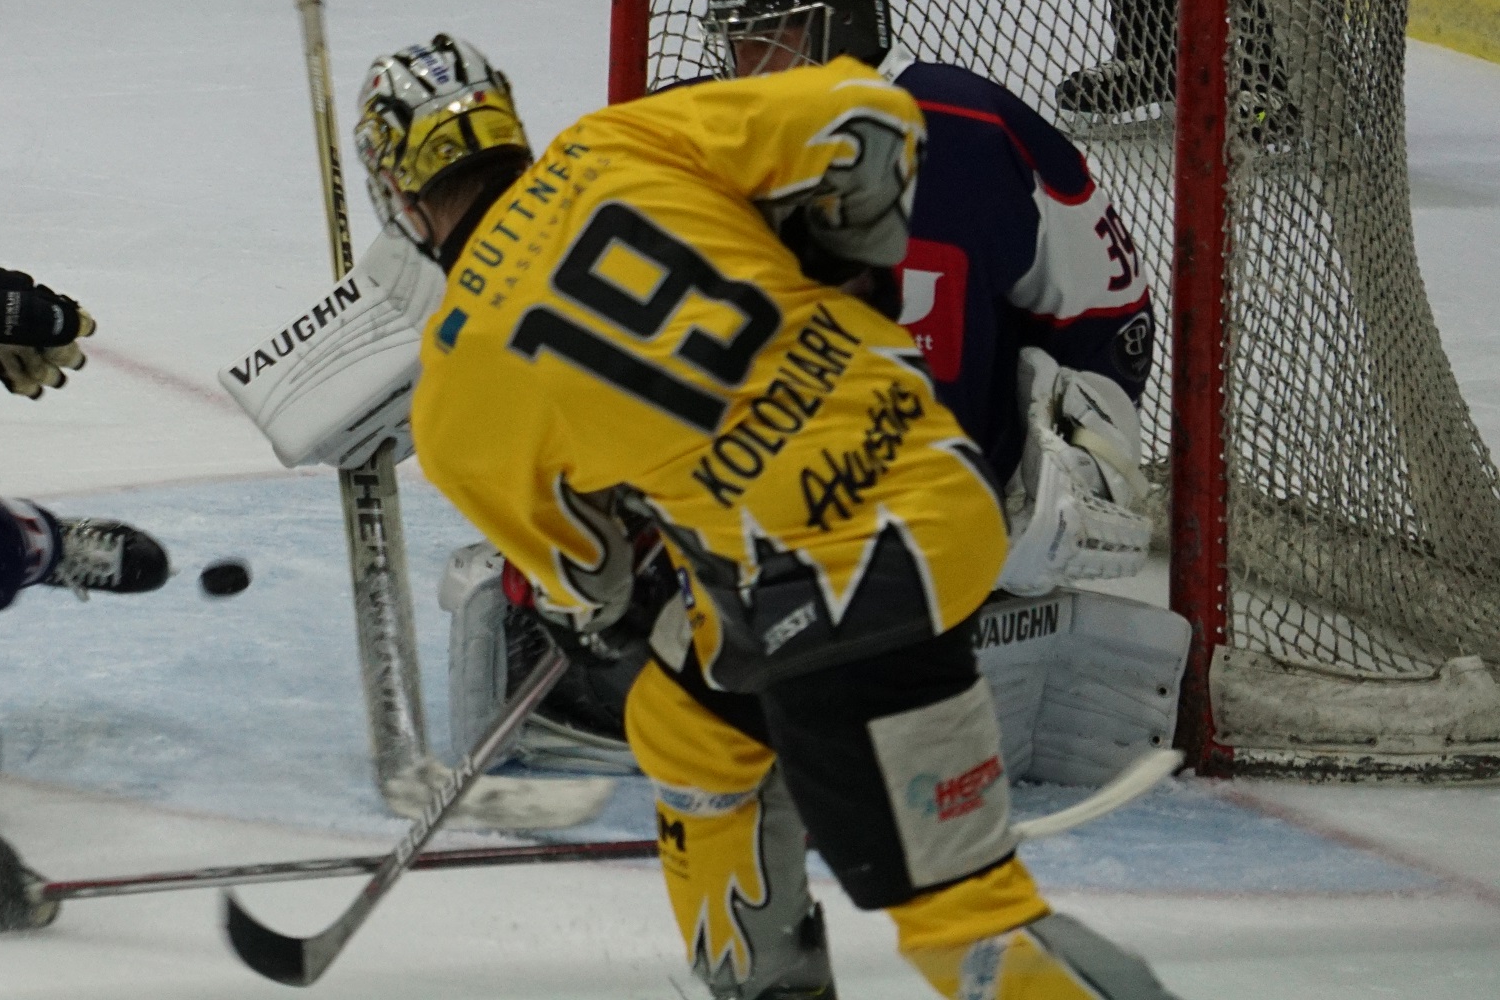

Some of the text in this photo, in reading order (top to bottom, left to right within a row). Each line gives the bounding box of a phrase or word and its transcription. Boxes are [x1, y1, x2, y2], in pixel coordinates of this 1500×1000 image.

[1094, 203, 1140, 292] 39
[229, 278, 362, 386] VAUGHN
[507, 200, 785, 436] 19
[975, 602, 1059, 650] VAUGHN
